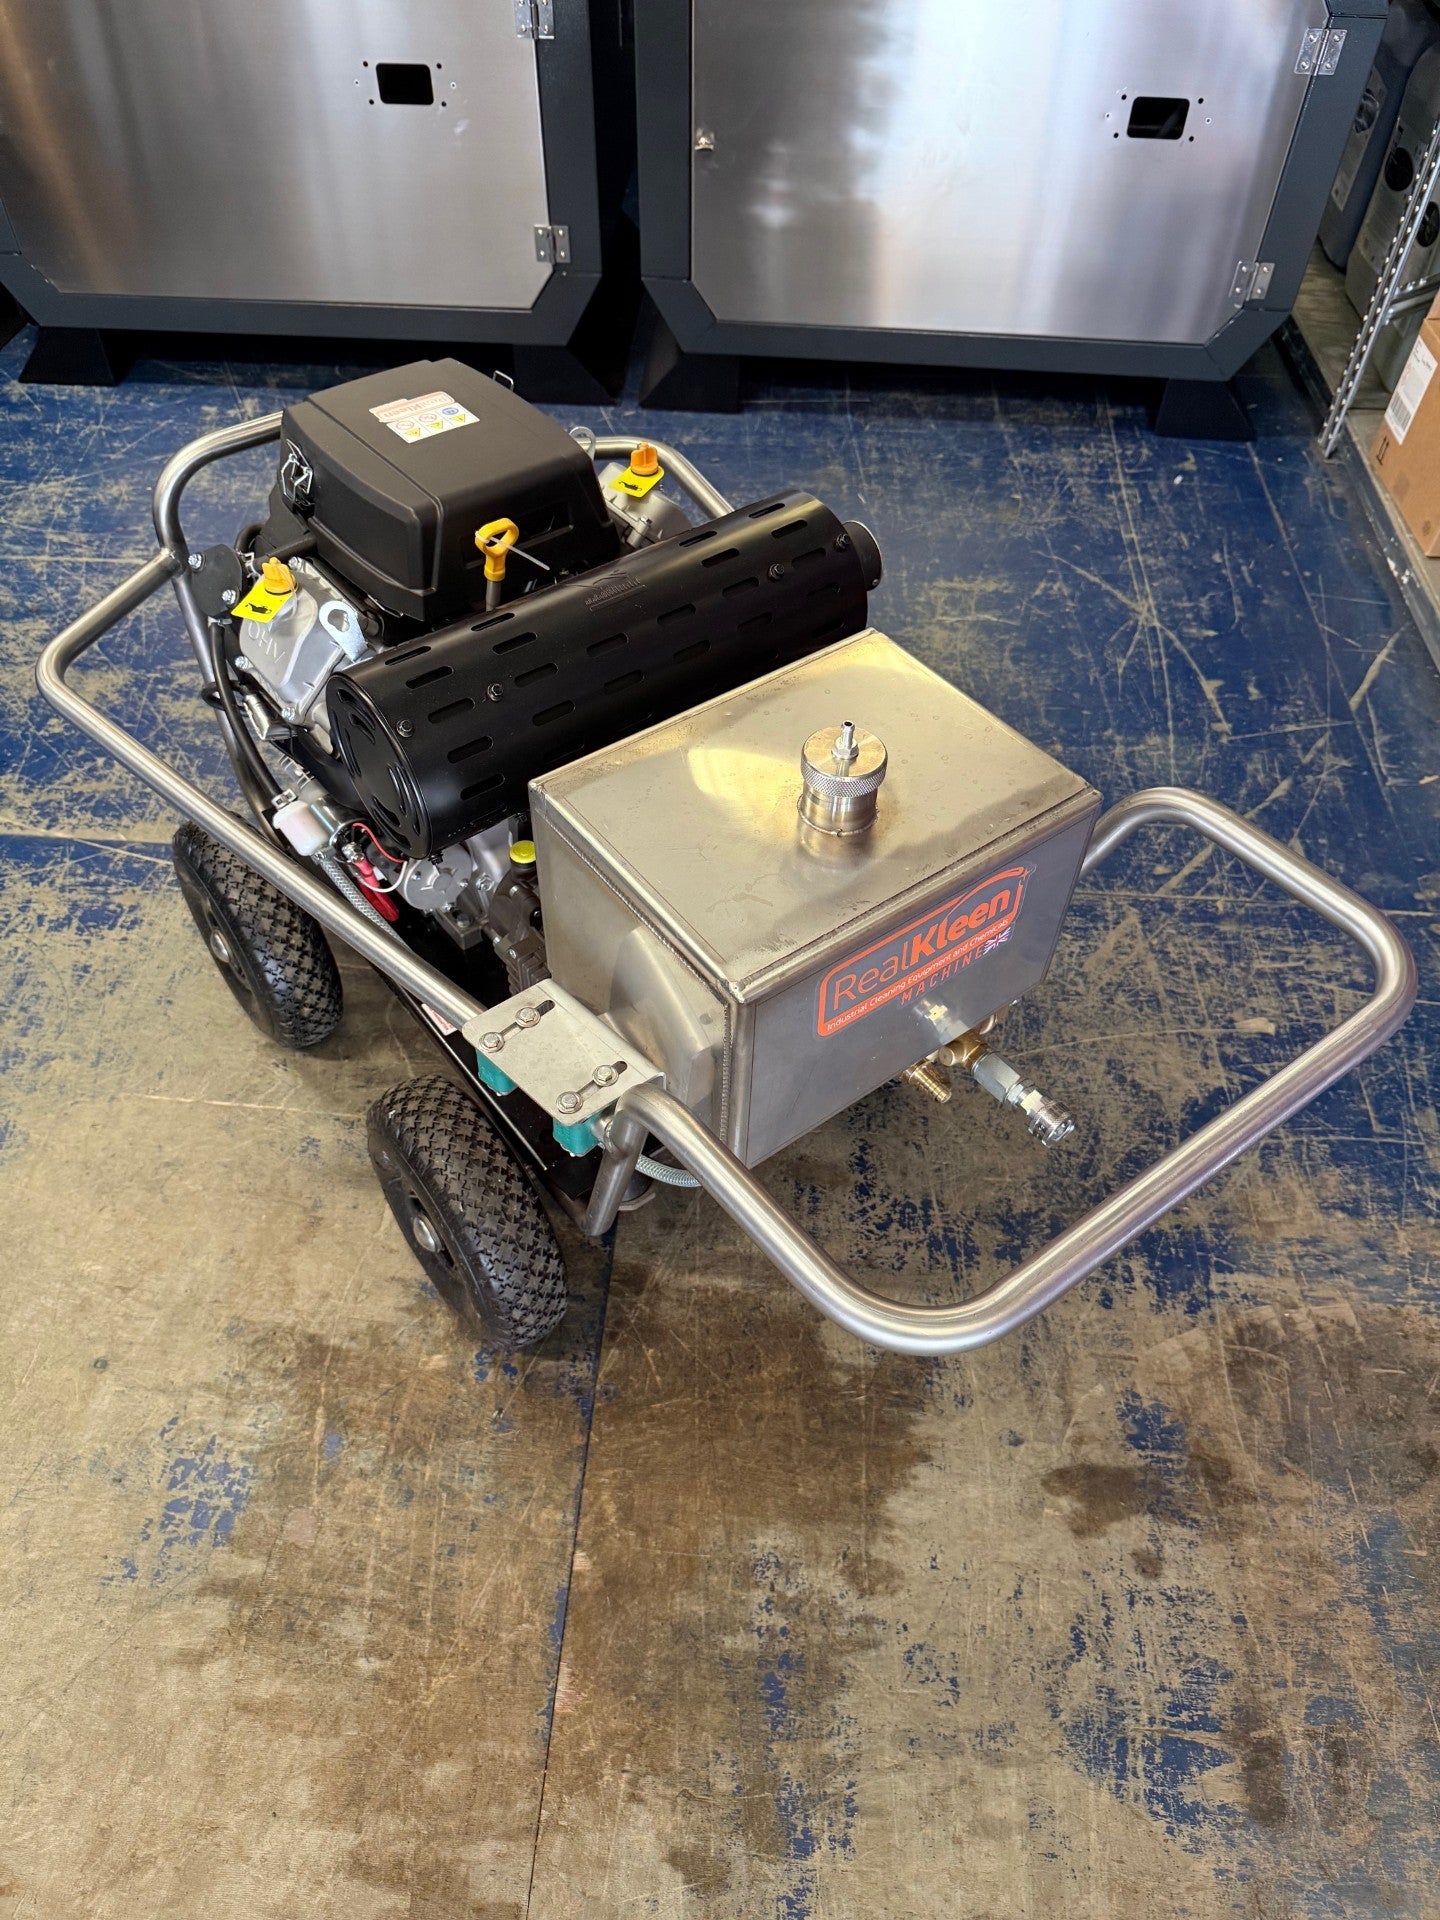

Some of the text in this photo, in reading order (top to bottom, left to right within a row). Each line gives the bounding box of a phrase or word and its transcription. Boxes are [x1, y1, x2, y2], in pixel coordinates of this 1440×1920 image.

[826, 919, 1009, 1032] Industrial Cleaning Equipment and Chemicals
[833, 889, 1011, 1011] RealKleen
